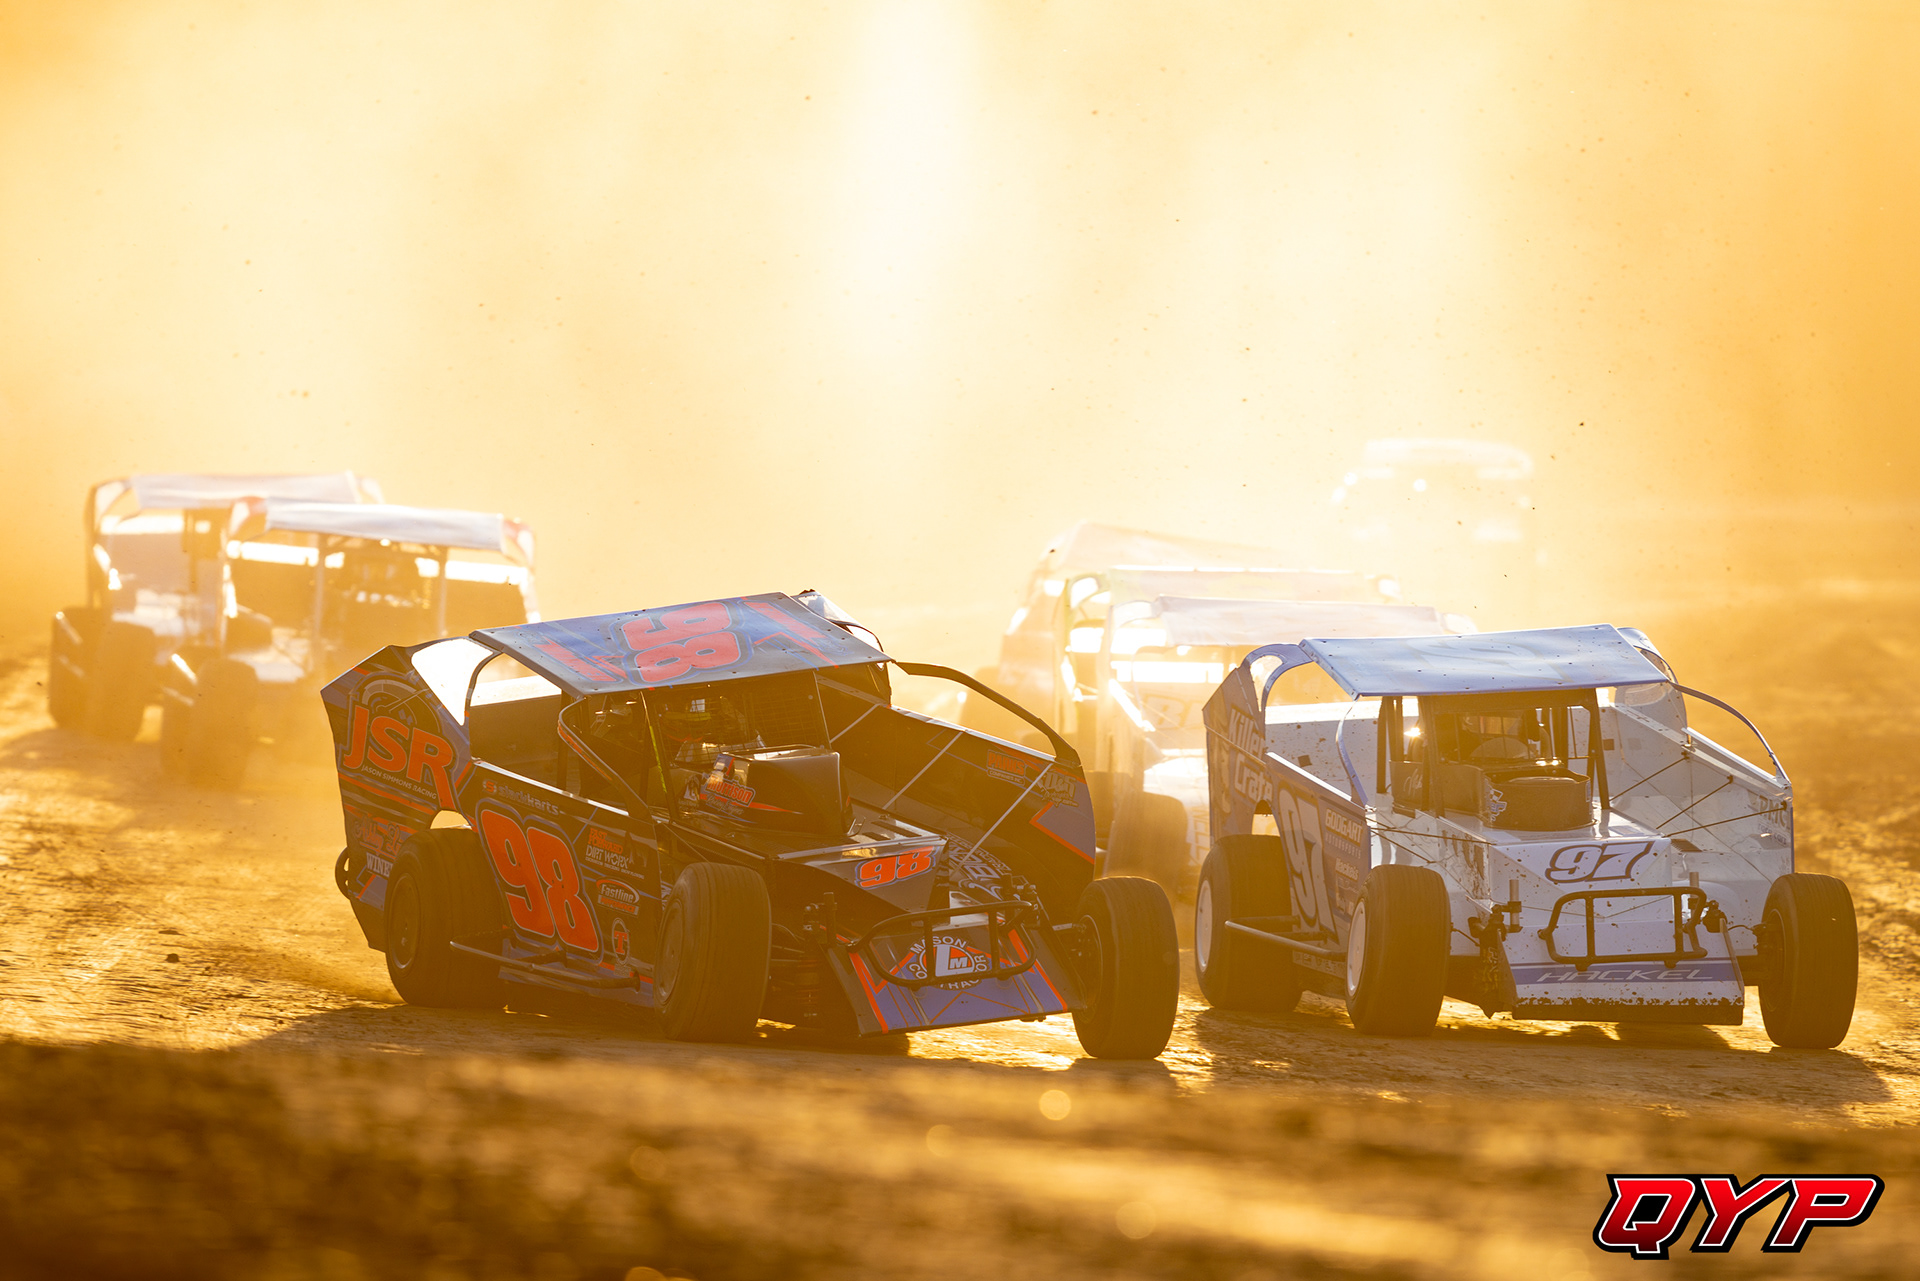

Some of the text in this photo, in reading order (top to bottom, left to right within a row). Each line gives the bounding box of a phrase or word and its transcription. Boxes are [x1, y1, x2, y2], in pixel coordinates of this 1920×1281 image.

[622, 602, 742, 683] 98
[1228, 707, 1266, 760] Killer
[343, 704, 456, 809] JSR
[1234, 752, 1273, 803] Crate
[361, 764, 437, 800] JASON SIMMONS RACING
[707, 776, 753, 804] Morrison
[585, 845, 603, 862] DIRT
[589, 827, 608, 841] FAST
[481, 809, 599, 953] 98
[859, 845, 933, 888] 98
[1278, 788, 1341, 946] 97
[1545, 840, 1657, 884] 97
[601, 884, 634, 904] Fastline
[1536, 968, 1713, 983] HACKEL
